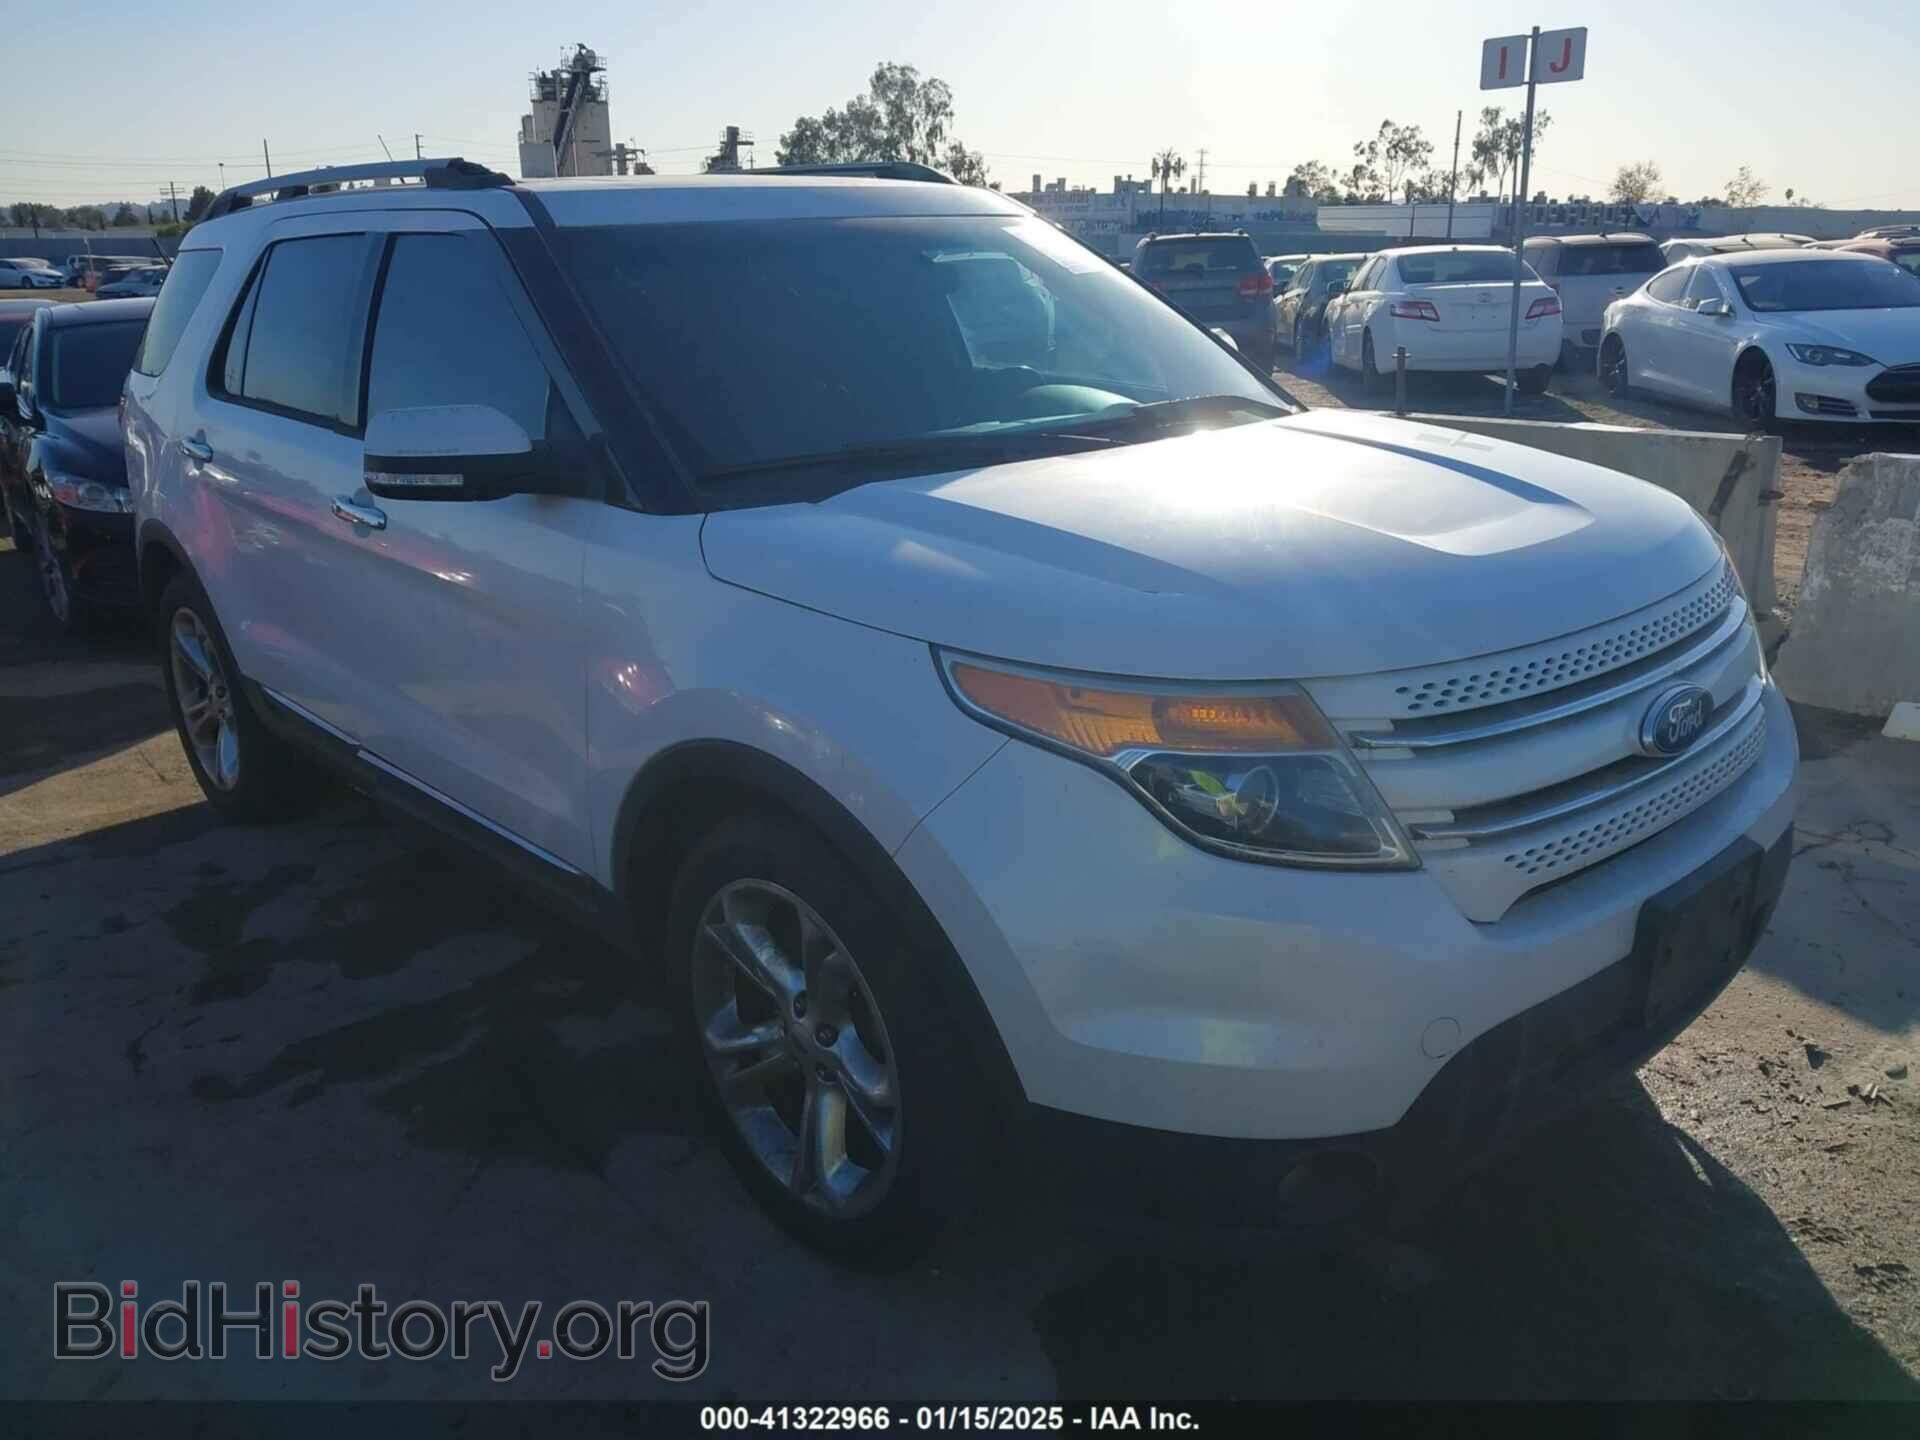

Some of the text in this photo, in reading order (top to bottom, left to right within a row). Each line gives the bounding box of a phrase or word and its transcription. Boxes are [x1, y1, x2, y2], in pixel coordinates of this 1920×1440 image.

[1499, 46, 1508, 80] I
[1550, 38, 1572, 73] J
[1668, 698, 1704, 742] Ford
